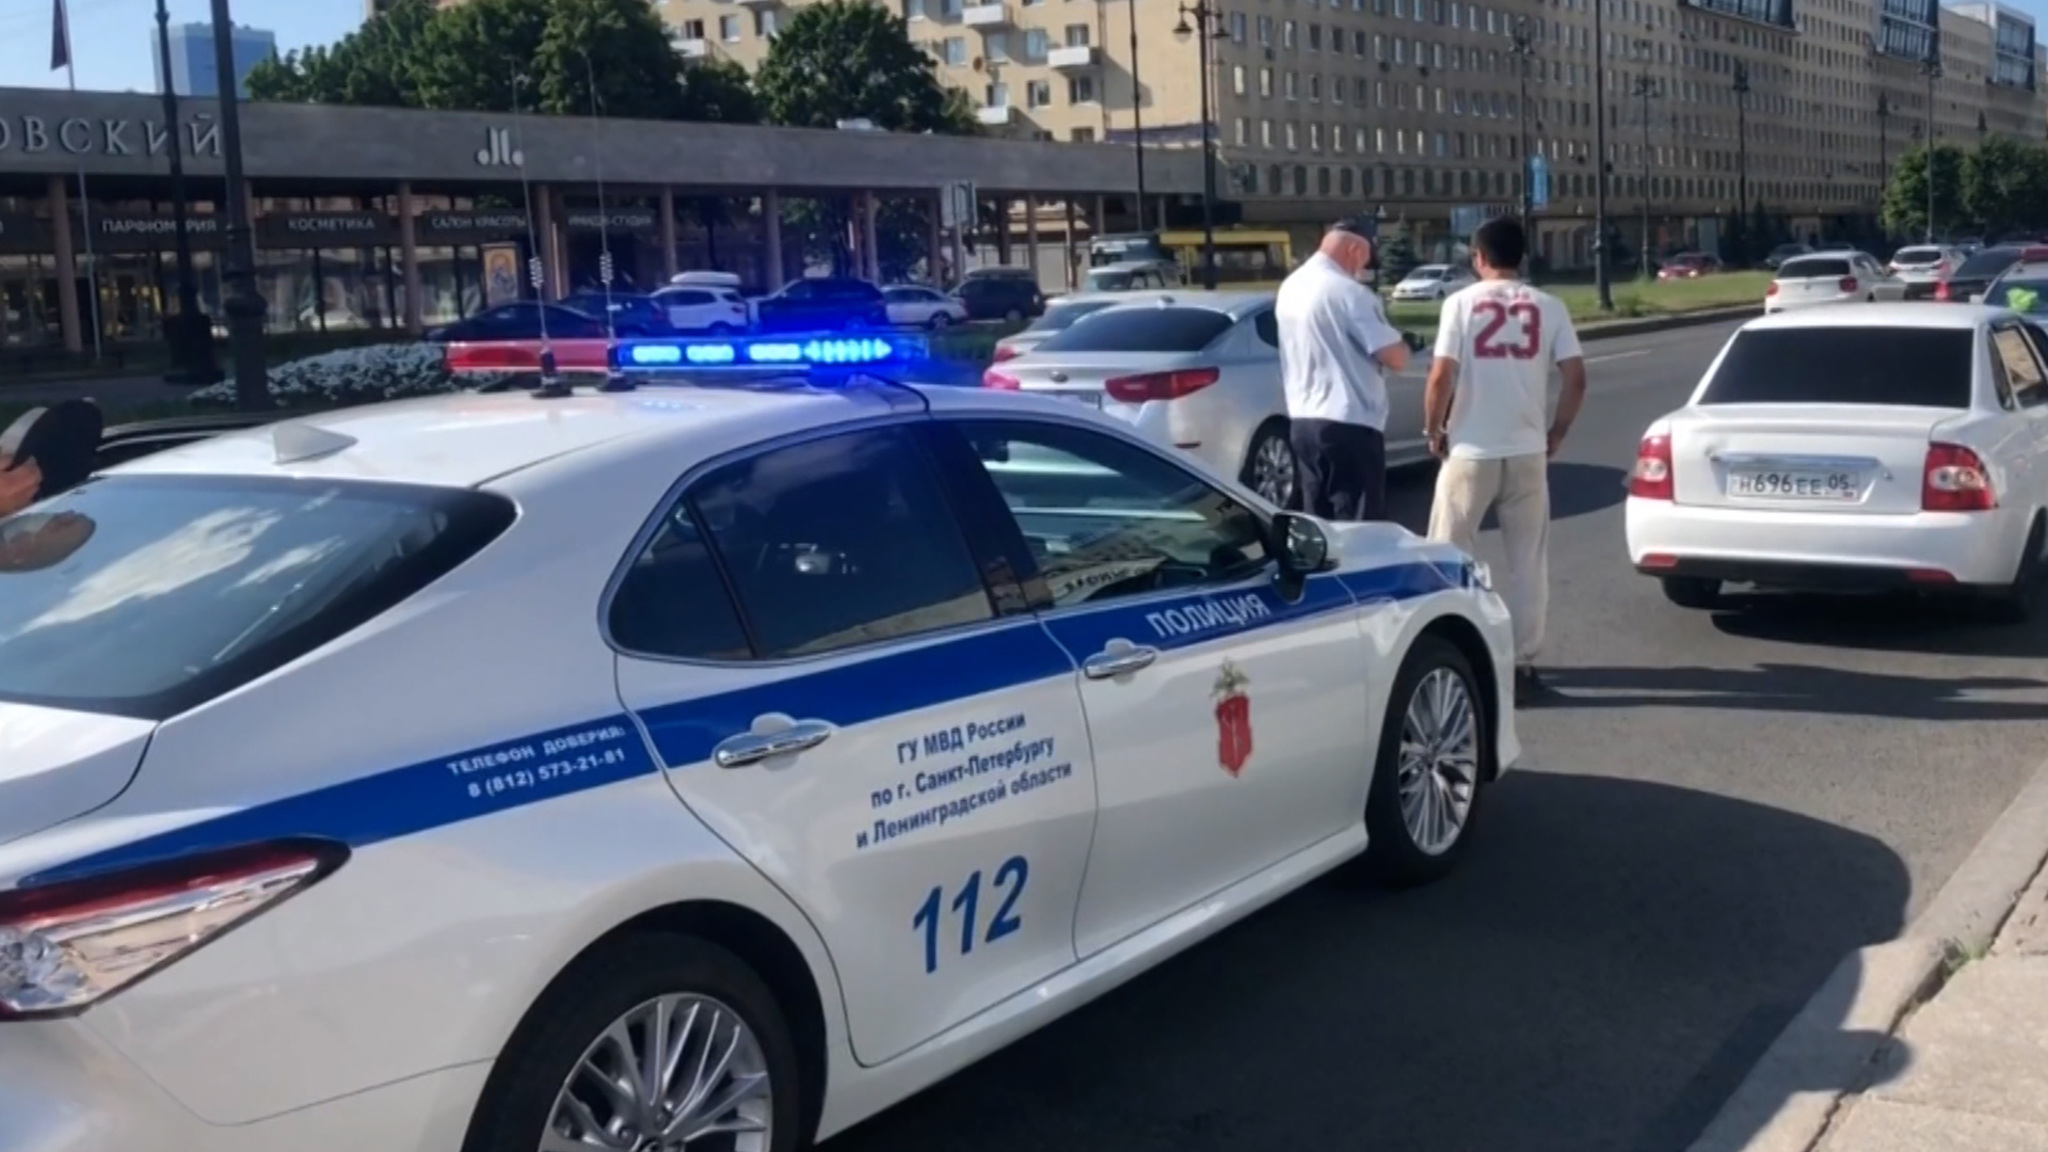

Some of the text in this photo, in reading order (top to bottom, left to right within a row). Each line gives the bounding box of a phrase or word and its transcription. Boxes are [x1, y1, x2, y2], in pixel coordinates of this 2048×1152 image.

[103, 219, 217, 233] ПАРФЮМРИЯ
[288, 216, 375, 230] КОСМЕТИКА
[432, 215, 528, 229] САЛОН КРАСОТЫ
[1472, 301, 1541, 359] 23
[1145, 593, 1271, 638] ПОЛИЦИЯ
[447, 725, 626, 776] ТЕЛЕФОН ДОВЕРИЯ:
[897, 712, 1026, 764] ГУ МВД России
[468, 748, 625, 798] 8 (812) 573-21-81
[871, 736, 1054, 808] по г. Санкт-Петербургу
[856, 761, 1072, 848] и Ленинградской области
[912, 855, 1029, 974] 112
